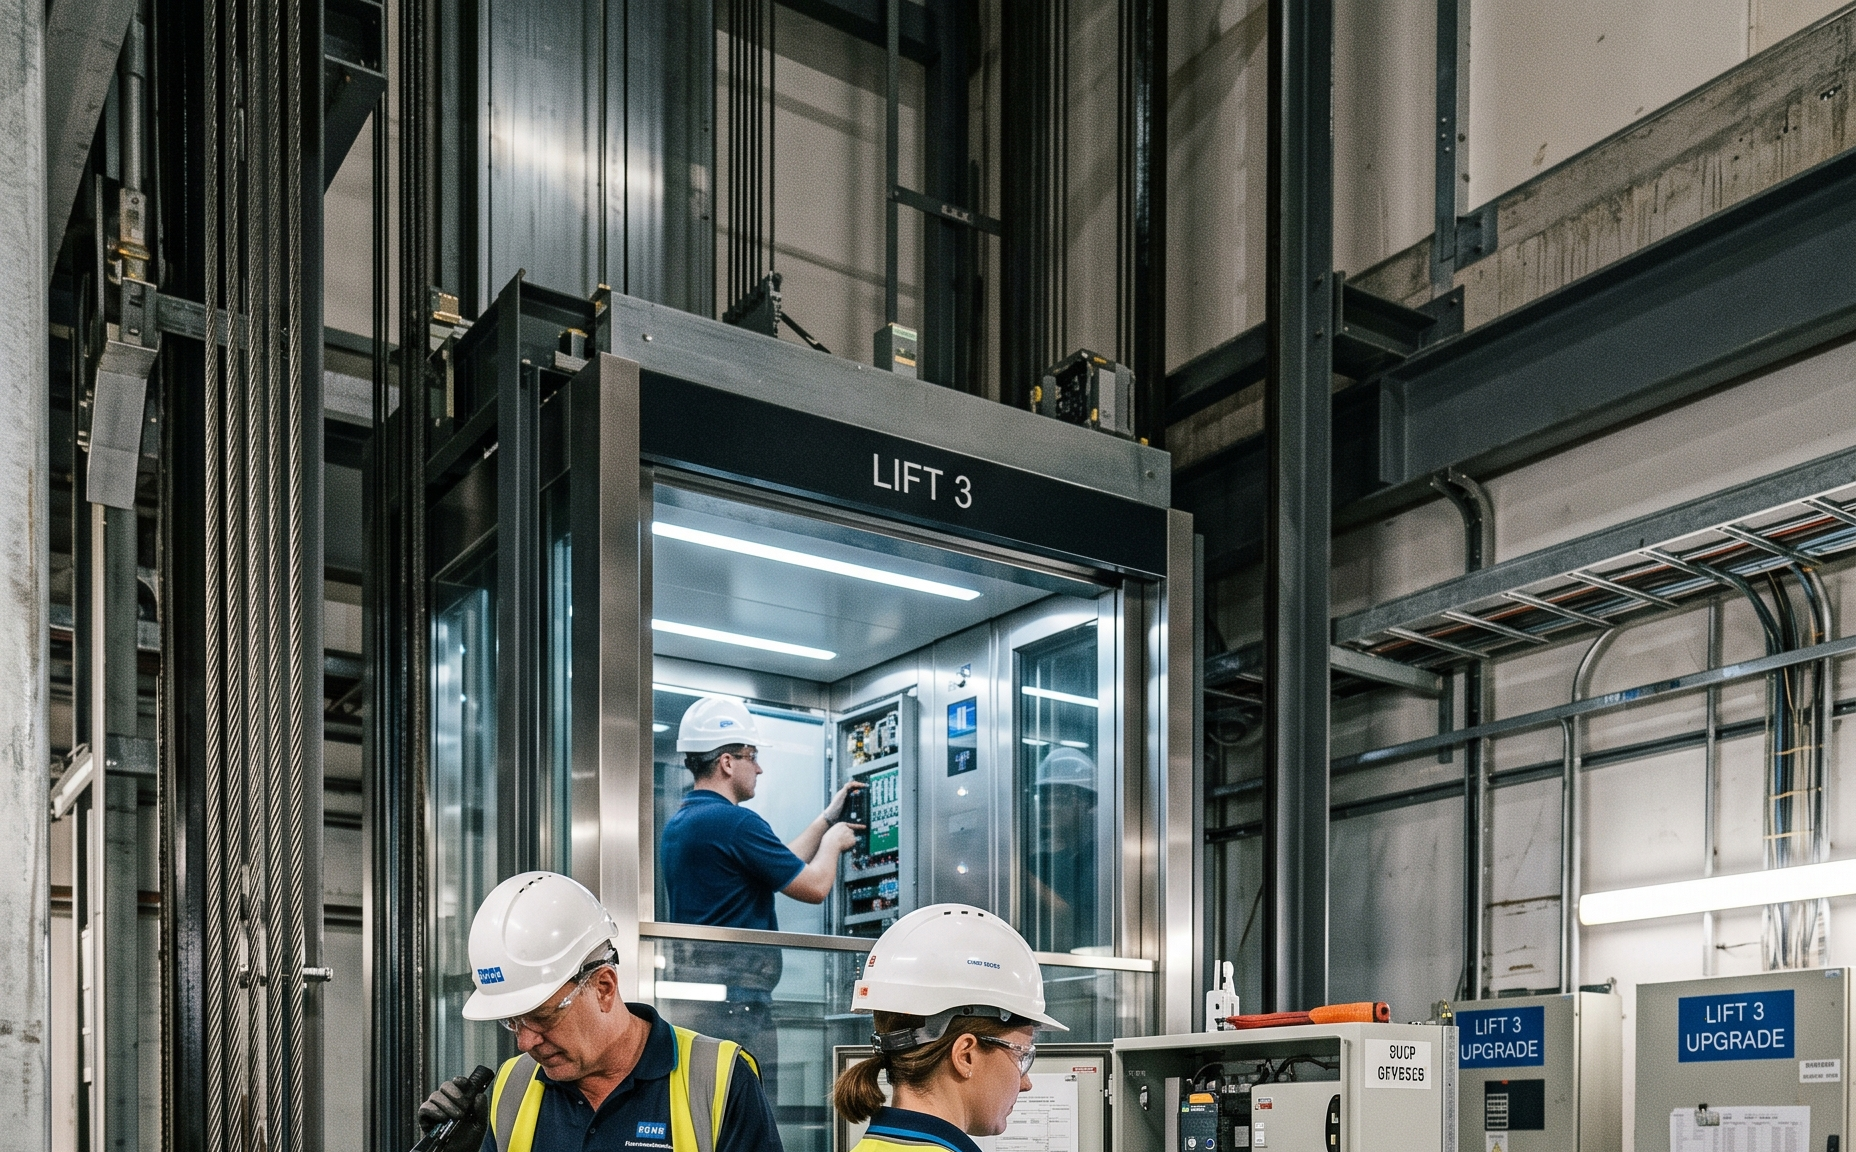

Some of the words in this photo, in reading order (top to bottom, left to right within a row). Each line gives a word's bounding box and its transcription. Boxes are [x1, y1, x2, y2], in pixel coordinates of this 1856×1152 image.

[873, 453, 944, 501] LIFT
[954, 475, 972, 509] 3
[1706, 1002, 1748, 1024] LIFT
[1753, 1001, 1765, 1021] 3
[1475, 1016, 1508, 1036] LIFT
[1512, 1016, 1522, 1033] 3
[1461, 1040, 1539, 1061] UPGRADE
[1686, 1028, 1785, 1053] UPGRADE
